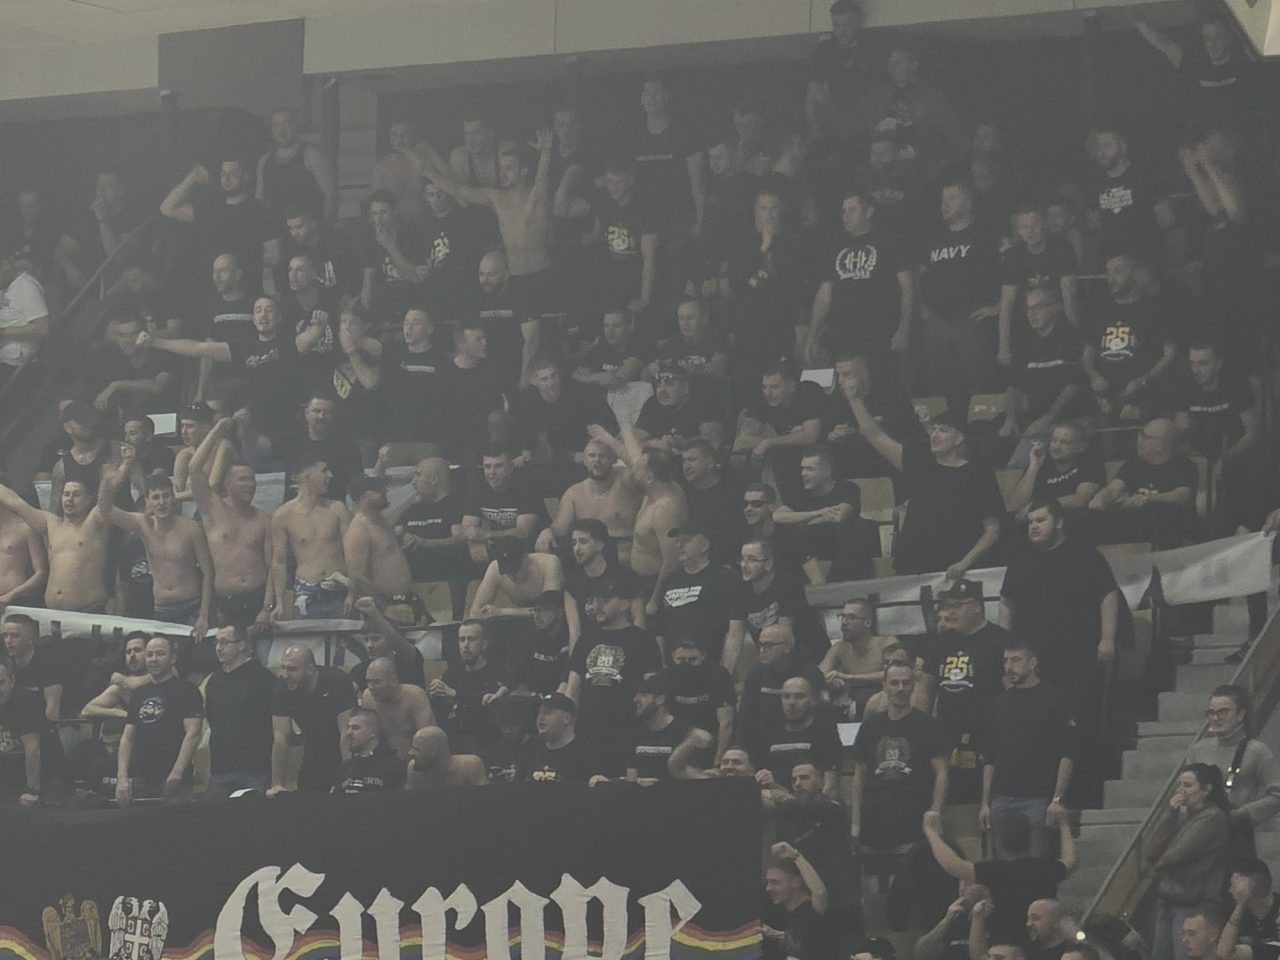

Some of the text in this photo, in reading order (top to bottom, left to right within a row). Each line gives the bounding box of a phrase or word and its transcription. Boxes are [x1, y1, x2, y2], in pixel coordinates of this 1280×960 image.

[930, 245, 970, 263] NAVY
[1105, 326, 1130, 350] 25
[944, 656, 969, 679] 25
